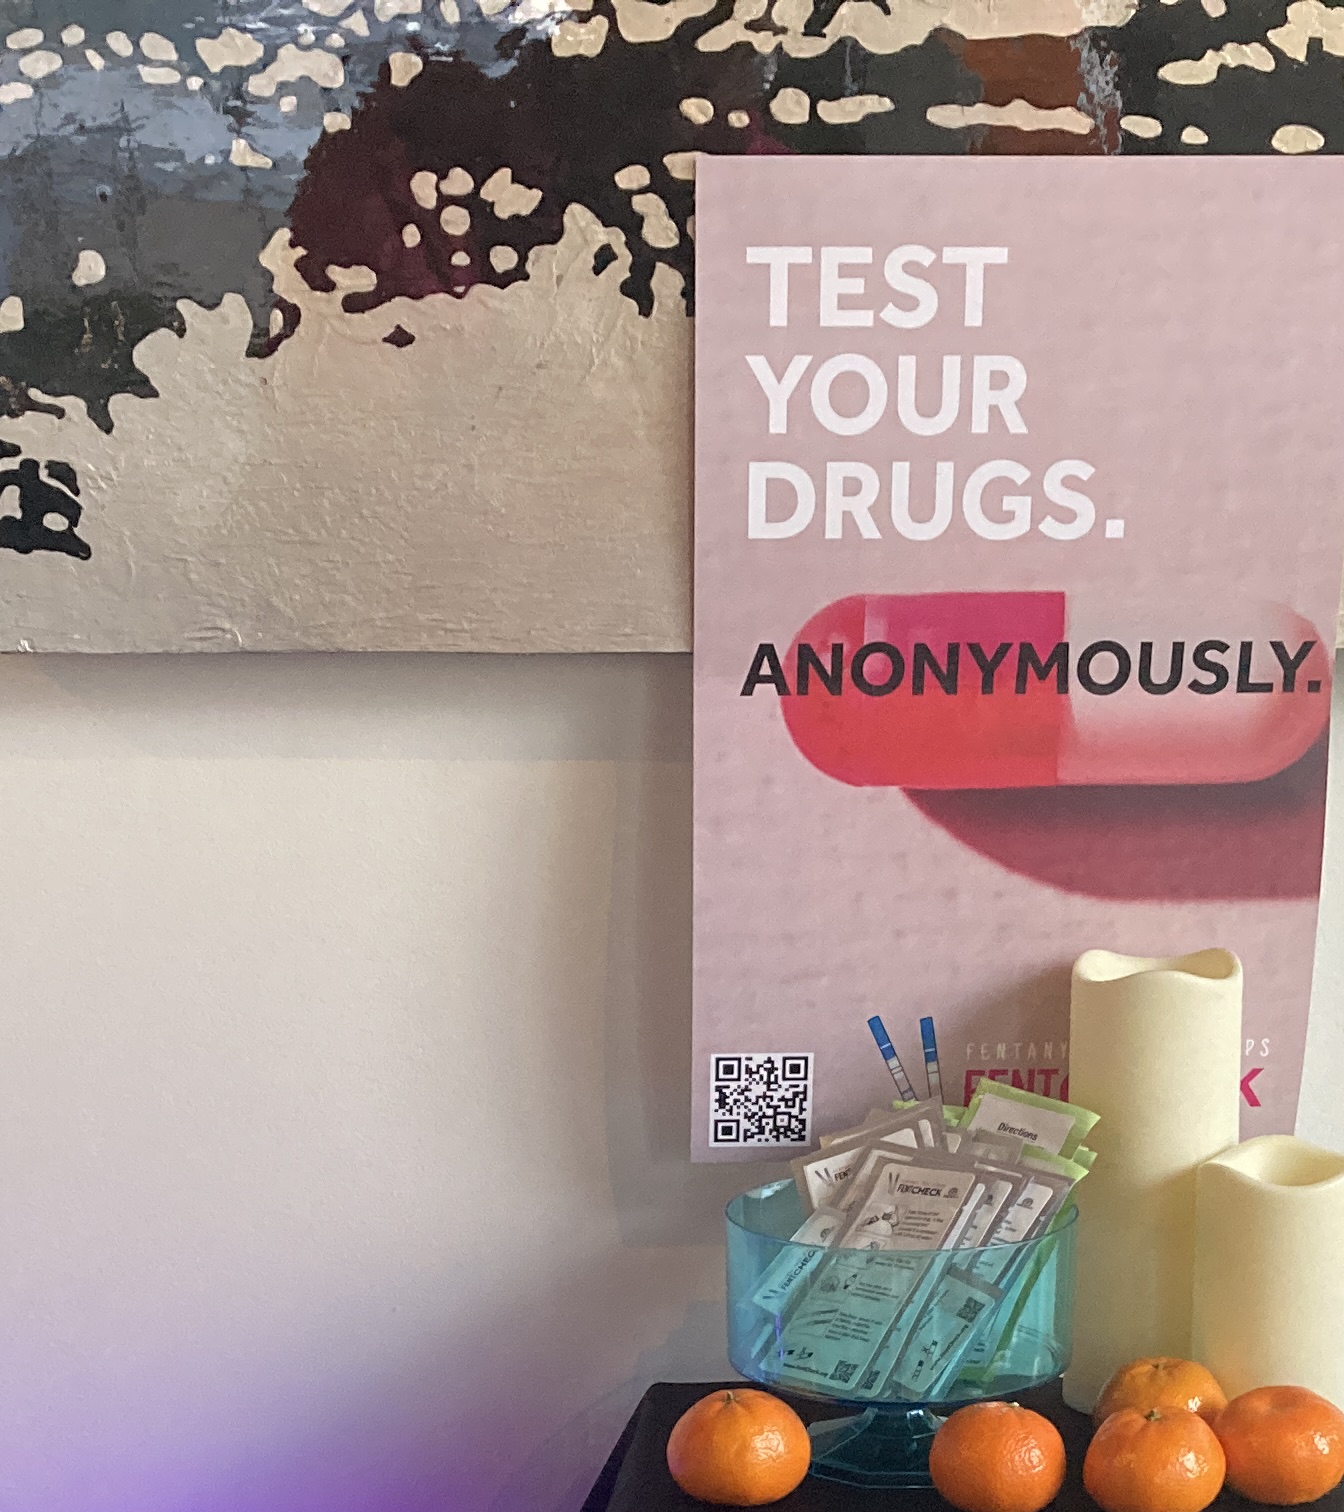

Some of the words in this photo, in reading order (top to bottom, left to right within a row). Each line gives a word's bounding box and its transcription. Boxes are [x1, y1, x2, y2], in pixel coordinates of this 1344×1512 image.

[746, 245, 1009, 329] TEST
[745, 352, 1030, 437] YOUR
[747, 458, 1126, 541] DRUGS.
[740, 638, 1322, 698] ANONYMOUSLY.
[997, 1121, 1039, 1141] Directions
